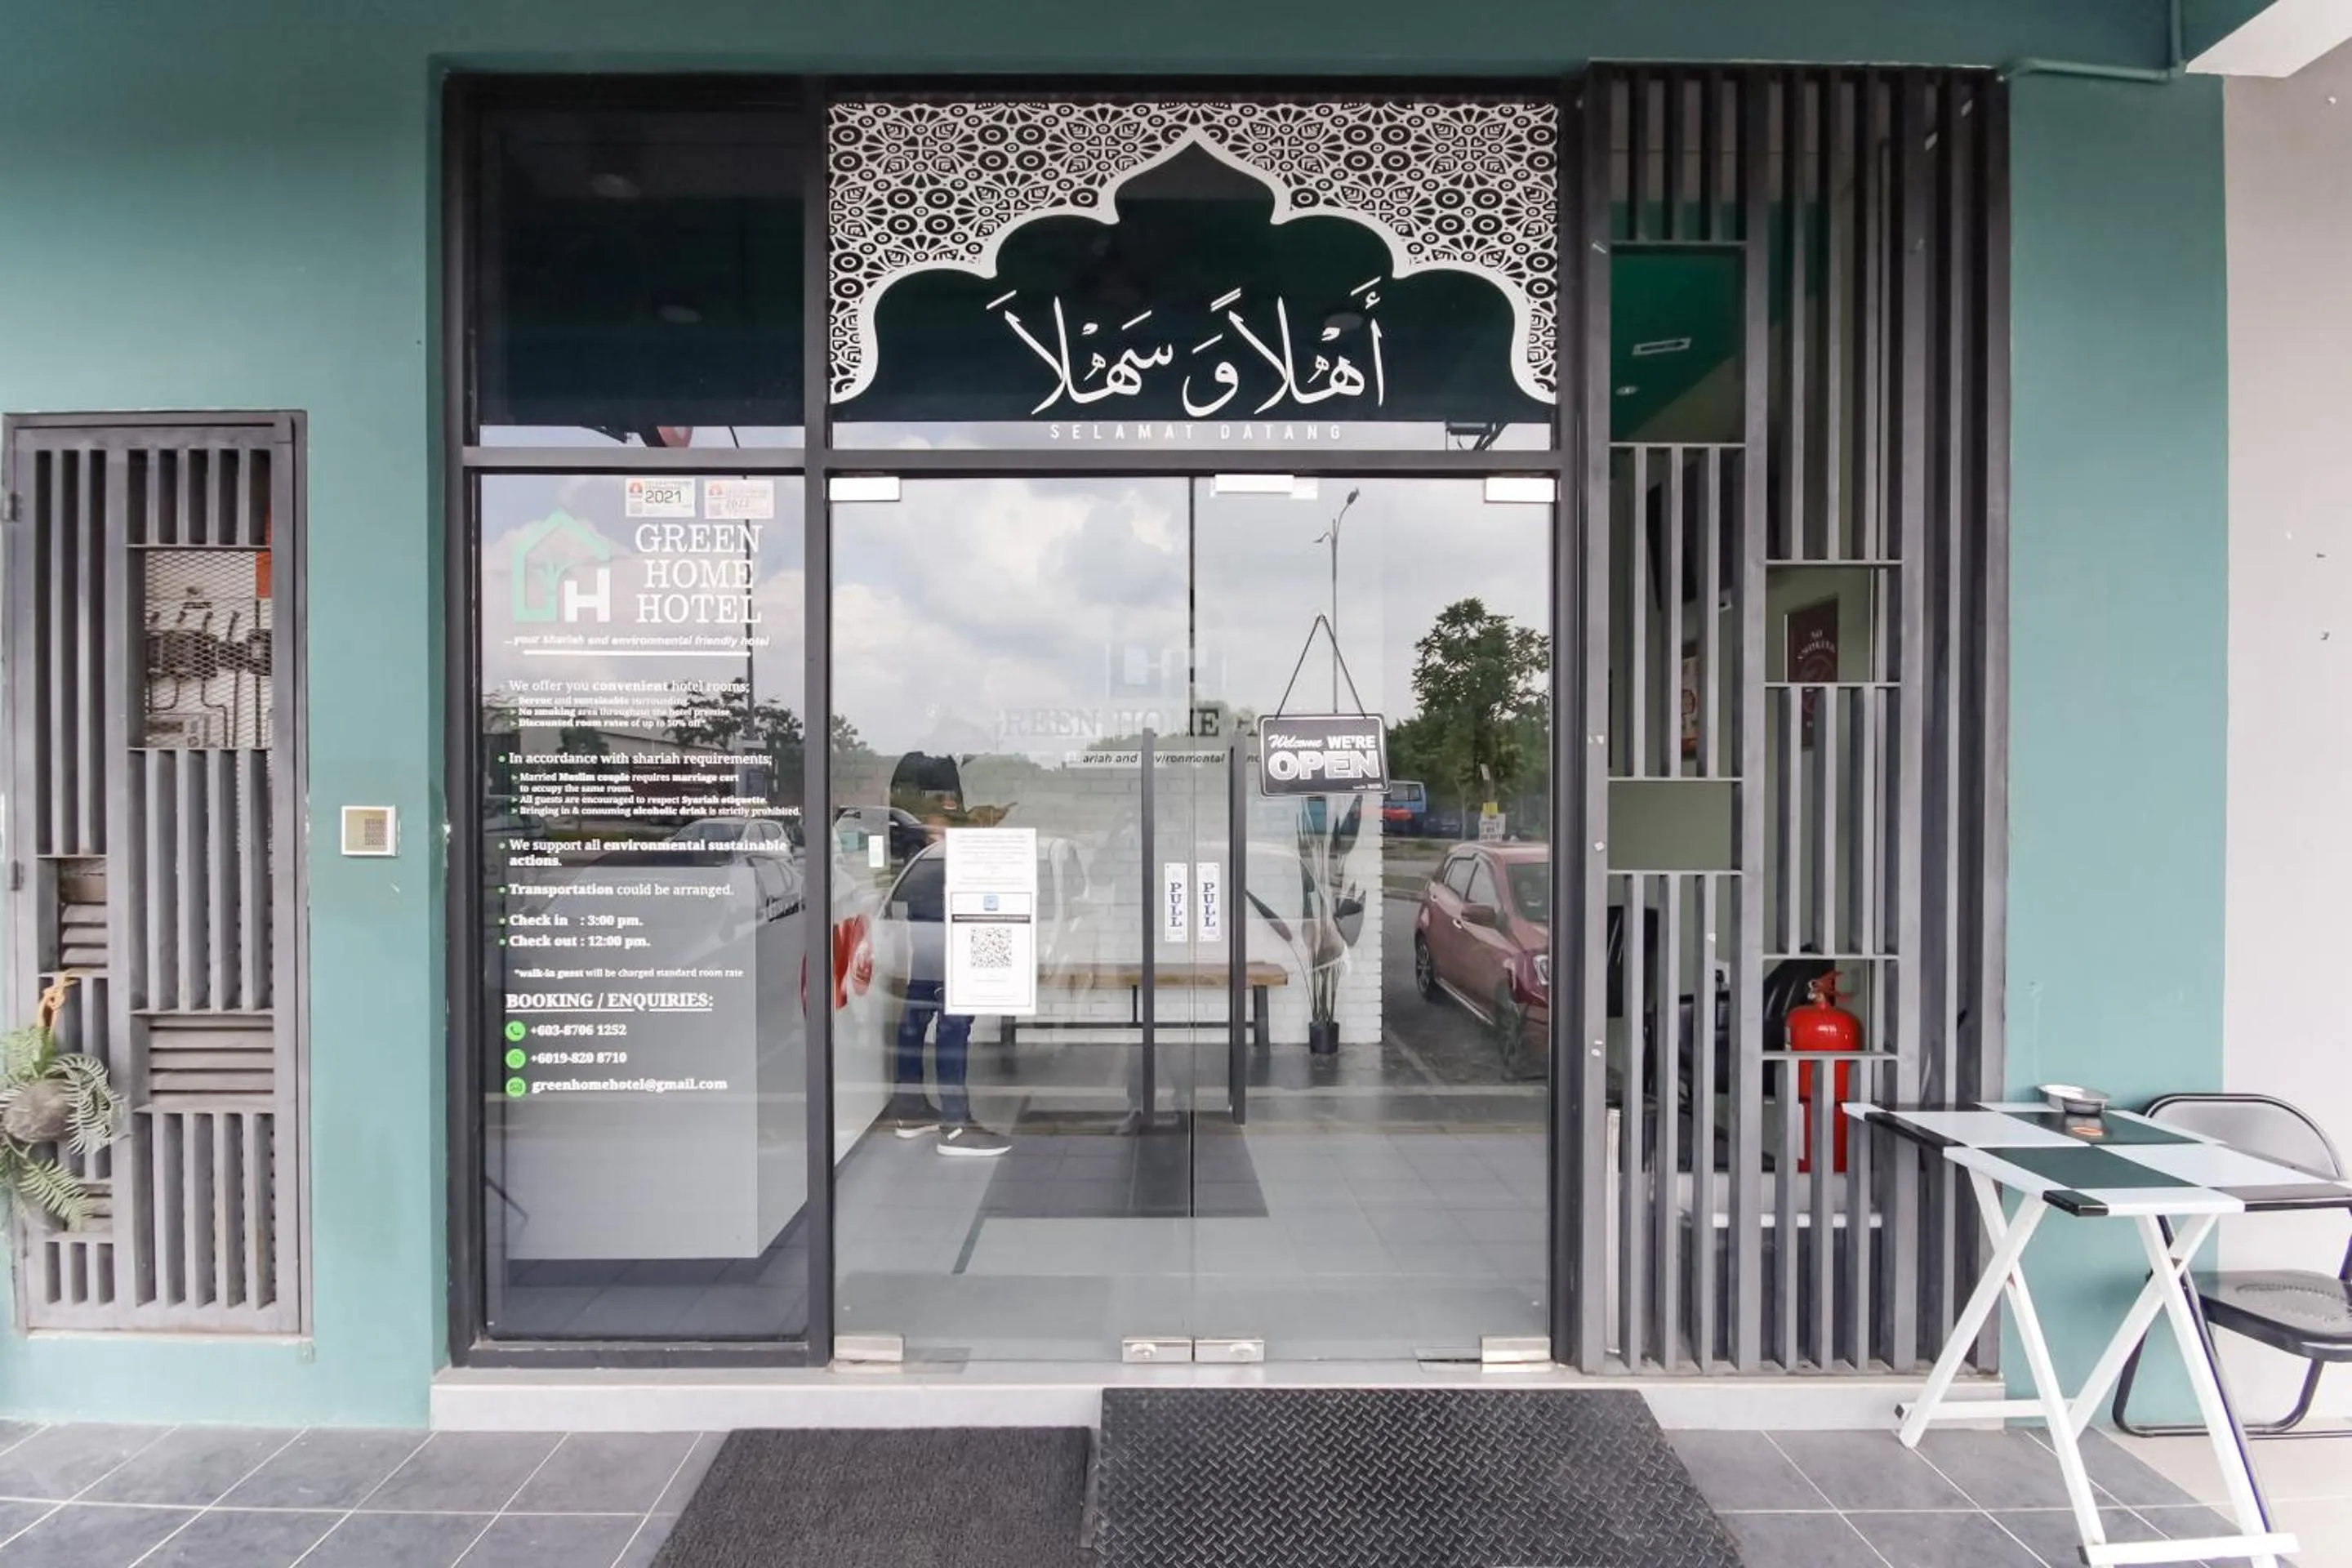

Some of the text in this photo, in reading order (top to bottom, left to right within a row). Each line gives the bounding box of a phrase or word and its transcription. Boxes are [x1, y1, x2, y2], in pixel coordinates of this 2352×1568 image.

[1051, 423, 1342, 440] SELAMAT DATANG
[645, 490, 682, 503] 2021
[635, 523, 764, 553] GREEN
[644, 559, 755, 589] HOME
[636, 595, 762, 623] HOTEL
[588, 635, 609, 645] and
[611, 635, 693, 646] environmental
[695, 635, 737, 648] friendly
[741, 635, 770, 646] hotel
[509, 679, 751, 693] We offer you convenient hotel rooms;
[519, 706, 532, 715] No
[534, 706, 576, 717] smoking
[670, 708, 693, 717] hotel
[519, 718, 573, 728] Discounted
[604, 719, 629, 727] rates
[630, 719, 640, 727] of
[643, 719, 653, 729] up
[1267, 733, 1376, 749] Welcome WE'RE
[509, 752, 772, 767] In accordance with shariah requirements;
[1116, 753, 1138, 763] and
[1267, 751, 1380, 781] OPEN
[520, 773, 739, 784] Married Muslim couple requires marriage cert
[520, 785, 528, 793] to
[532, 786, 563, 795] occupy
[607, 785, 634, 793] room.
[520, 795, 532, 804] All
[535, 795, 563, 805] guests
[581, 795, 634, 805] encouraged
[648, 796, 679, 805] respect
[682, 795, 719, 805] Syariah
[520, 806, 559, 817] Bringing
[561, 806, 570, 814] in
[581, 807, 631, 817] consuming
[633, 806, 677, 815] alcoholic
[679, 806, 708, 815] drink
[709, 807, 716, 815] is
[719, 806, 749, 817] strictly
[509, 839, 787, 853] We support all environmental sustainable
[509, 854, 563, 866] actions.
[509, 884, 734, 898] Transportation could be arranged.
[1169, 882, 1183, 927] PULL
[1203, 882, 1216, 927] PULL
[509, 914, 552, 926] Check
[555, 914, 568, 926] in
[587, 915, 614, 926] 3:00
[617, 916, 644, 929] pm.
[509, 935, 552, 947] Check
[555, 936, 577, 947] out
[588, 935, 621, 947] 12:00
[625, 937, 651, 949] pm.
[557, 969, 583, 979] guest
[586, 969, 603, 978] will
[605, 969, 617, 978] be
[617, 969, 654, 979] charged
[657, 969, 697, 978] standard
[506, 993, 594, 1009] BOOKING
[608, 993, 715, 1011] ENQUIRIES:
[531, 1024, 627, 1036] +603-8706 1252
[597, 1052, 627, 1063] 8710
[532, 1079, 728, 1094] greenhomehotel@gmail.com
